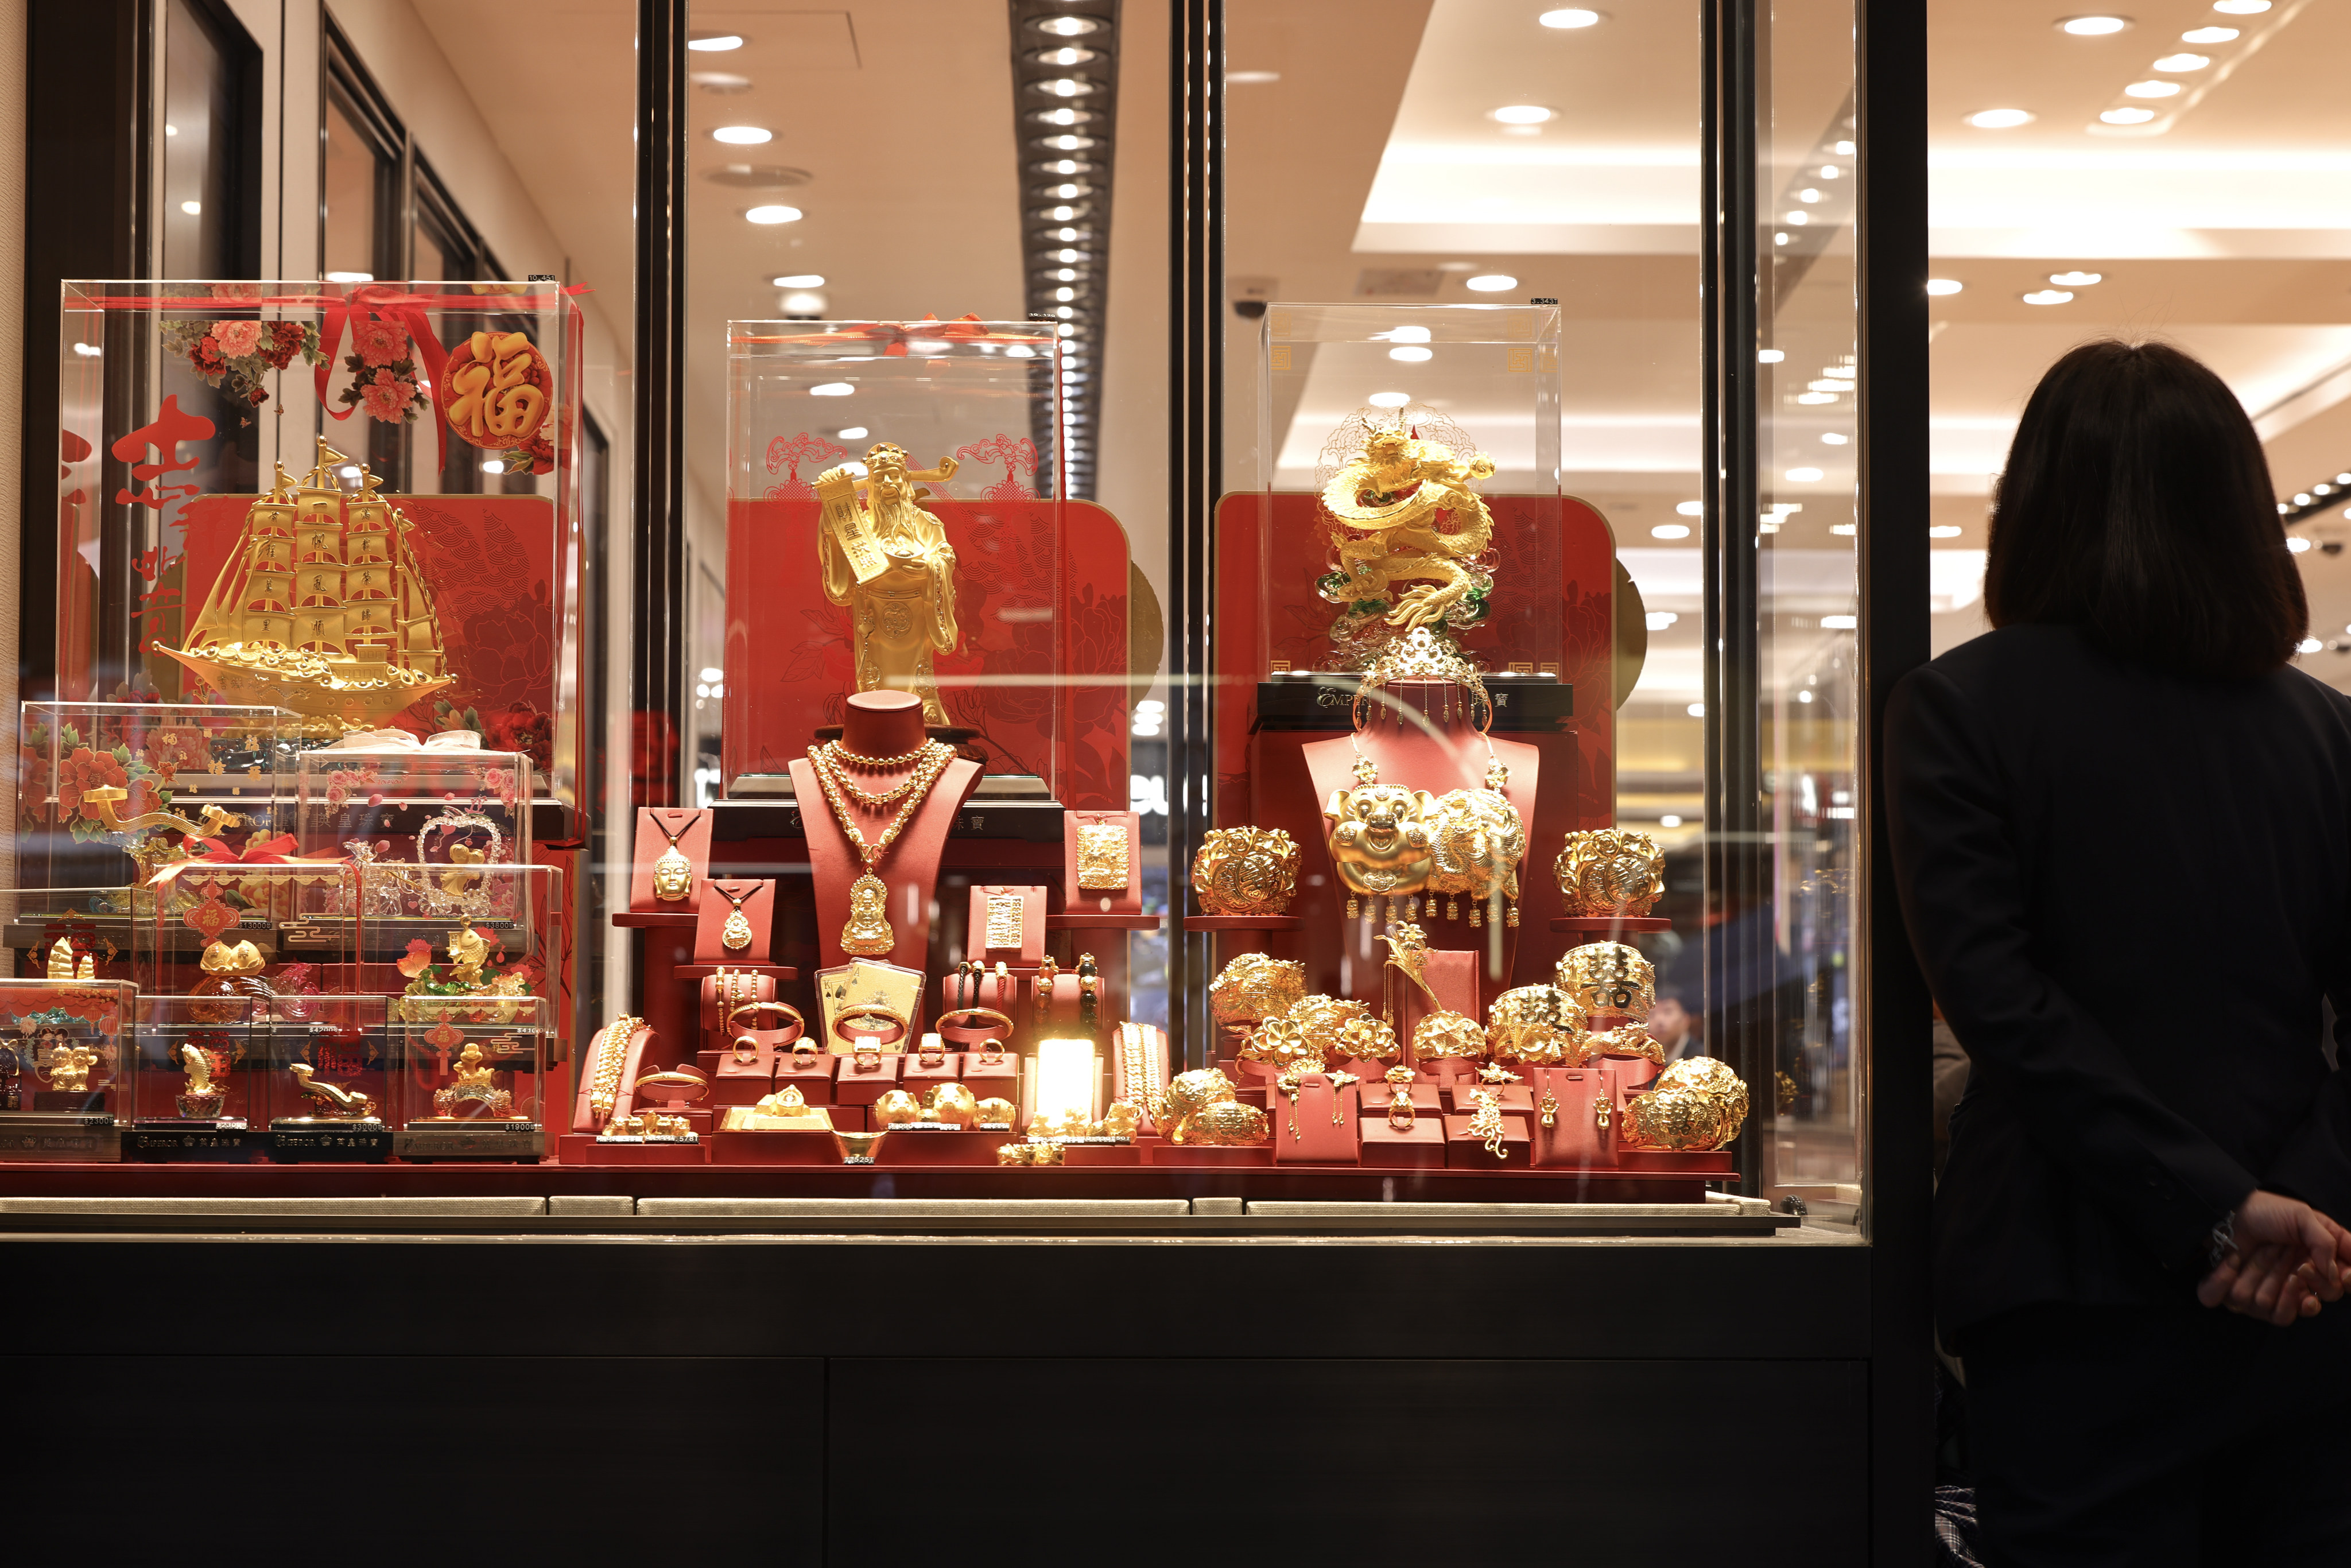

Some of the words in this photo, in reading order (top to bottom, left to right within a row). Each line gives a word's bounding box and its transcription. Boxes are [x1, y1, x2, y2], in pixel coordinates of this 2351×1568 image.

[448, 331, 544, 438] 福
[310, 501, 329, 638] 一帆風順
[1316, 686, 1371, 708] EMPER
[1473, 692, 1508, 708] 珠寶
[854, 967, 860, 977] A
[824, 980, 832, 990] K
